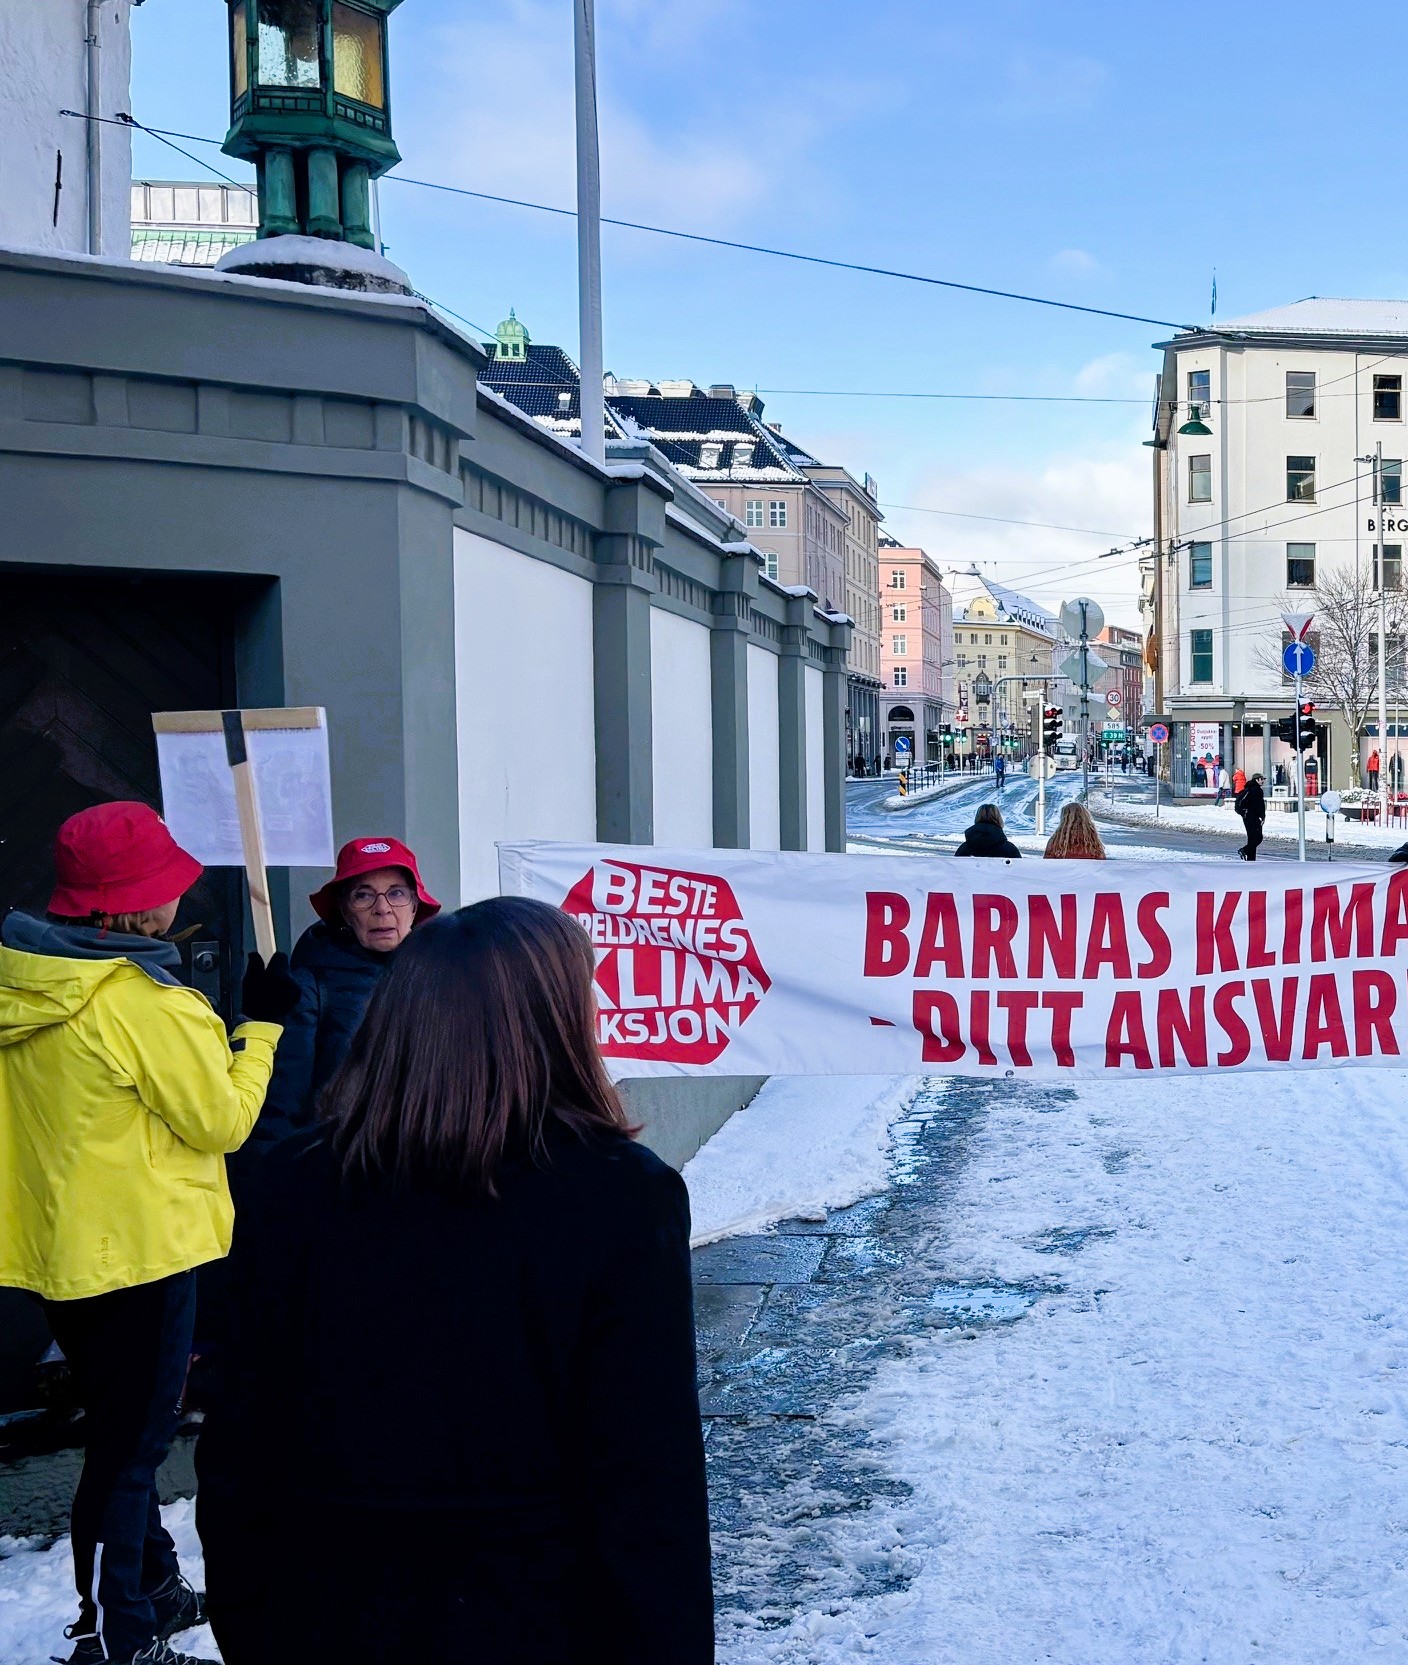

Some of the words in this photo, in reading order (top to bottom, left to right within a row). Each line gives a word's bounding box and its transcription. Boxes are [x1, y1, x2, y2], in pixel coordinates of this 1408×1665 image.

[1109, 694, 1119, 702] 30
[590, 864, 718, 917] BESTE
[567, 912, 748, 963] RELDRENES
[864, 891, 1171, 980] BARNAS
[597, 1005, 740, 1046] KSJON
[912, 990, 1084, 1068] DITT
